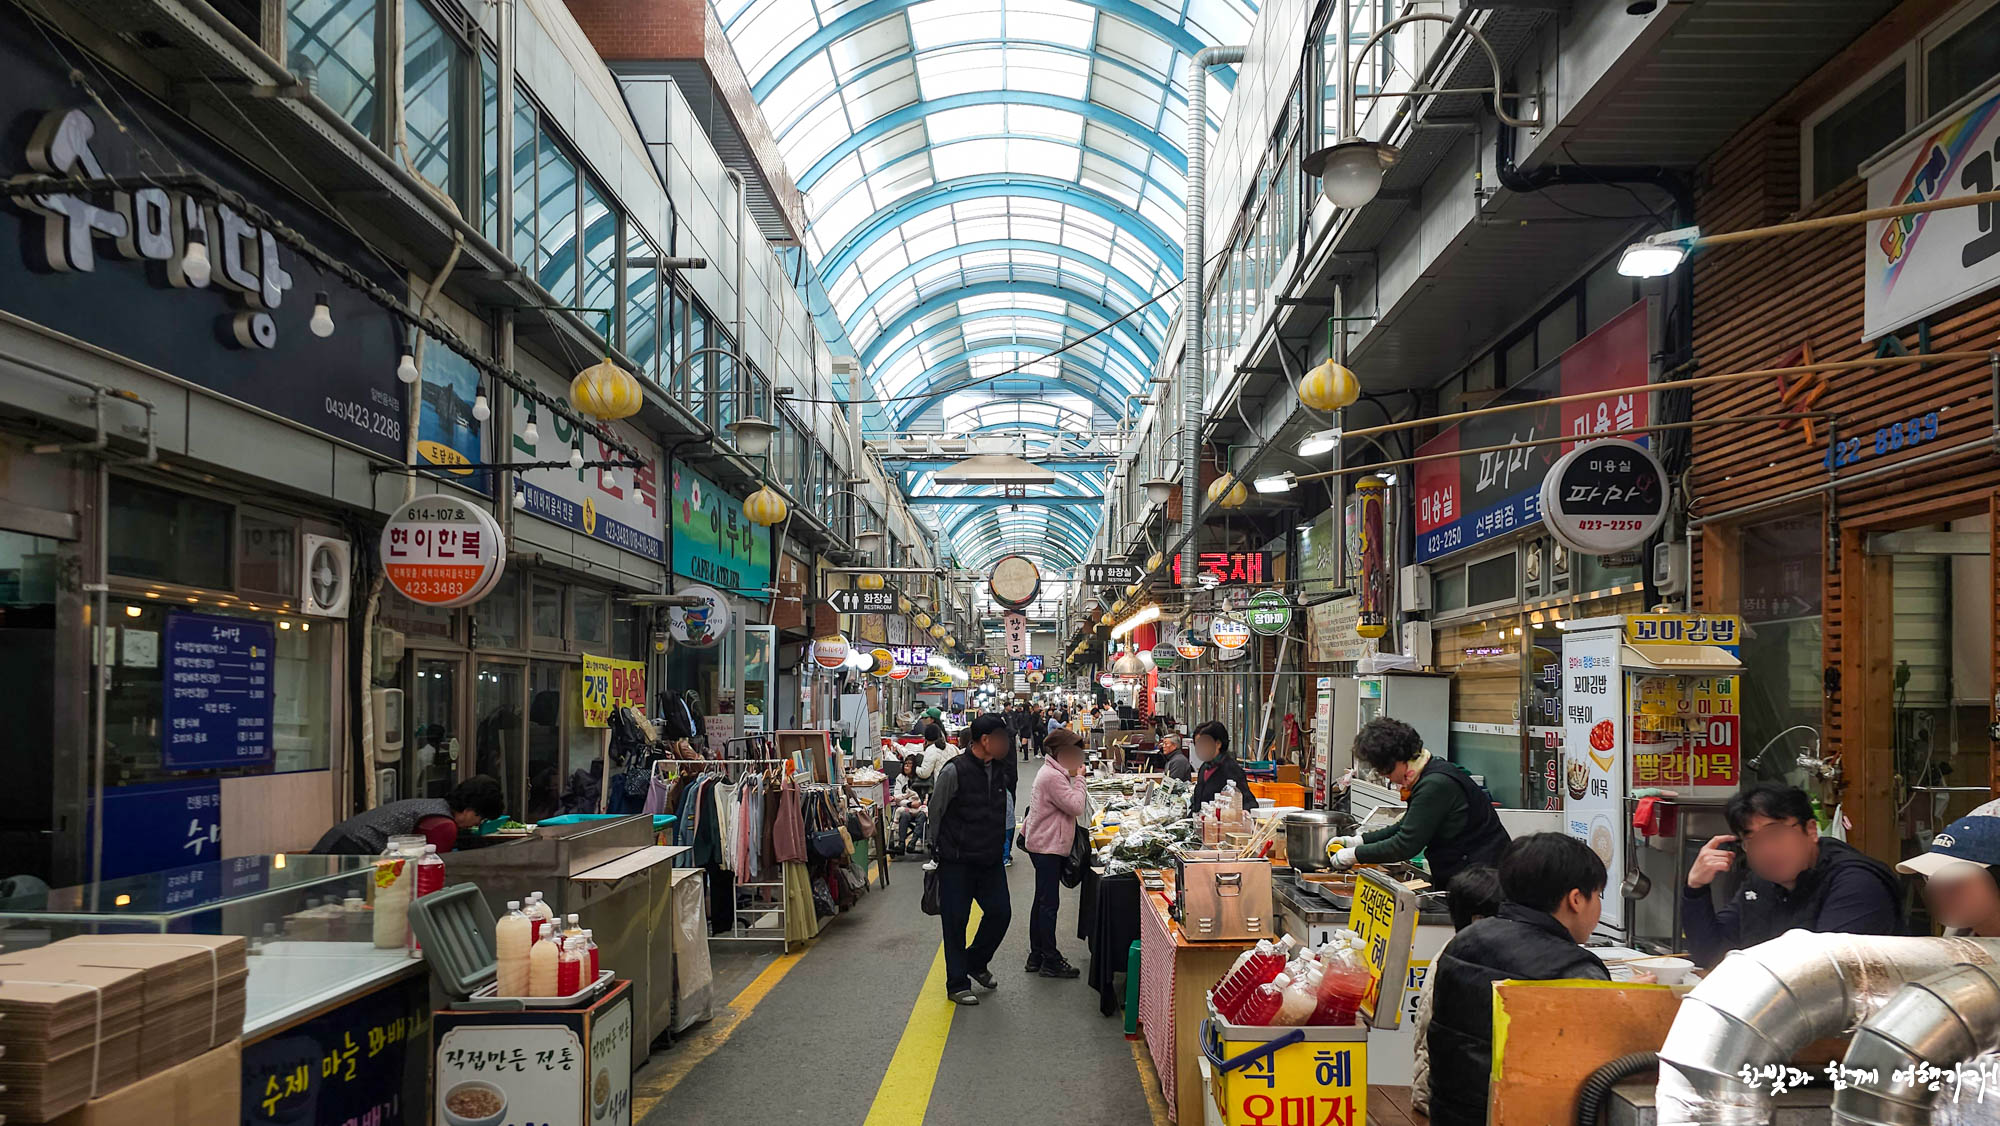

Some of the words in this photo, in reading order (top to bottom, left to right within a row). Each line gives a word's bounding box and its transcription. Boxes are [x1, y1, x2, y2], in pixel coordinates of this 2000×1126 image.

[30, 108, 292, 349] 수미당
[1574, 394, 1634, 450] 미용실
[1874, 412, 1939, 455] 8689
[1590, 460, 1631, 473] 미용실
[1421, 486, 1453, 526] 미용실
[711, 497, 754, 568] 이루다
[1476, 503, 1518, 539] 신부화장,
[1579, 519, 1642, 531] 423-2250
[390, 528, 480, 559] 현이한복
[1428, 526, 1462, 554] 423-2250
[692, 556, 710, 580] CAFE
[1107, 567, 1132, 577] 화장실
[405, 582, 463, 595] 423-3483
[863, 592, 893, 604] 화장실
[672, 619, 687, 631] afe
[1008, 616, 1023, 655] 장보고
[1634, 619, 1736, 642] 꼬마김밥
[1573, 675, 1607, 694] 꼬마김밥
[1568, 706, 1593, 724] 떡볶이
[1676, 699, 1733, 714] 오미자
[1636, 753, 1733, 781] 빨간어묵
[1591, 778, 1608, 799] 어묵
[1360, 884, 1396, 928] 직접만든
[446, 1049, 528, 1073] 직접만든
[536, 1047, 575, 1072] 전통
[1239, 1050, 1352, 1089] 식혜
[262, 1064, 310, 1118] 수제
[322, 1031, 361, 1082] 마늘
[1240, 1094, 1358, 1126] 오미자
